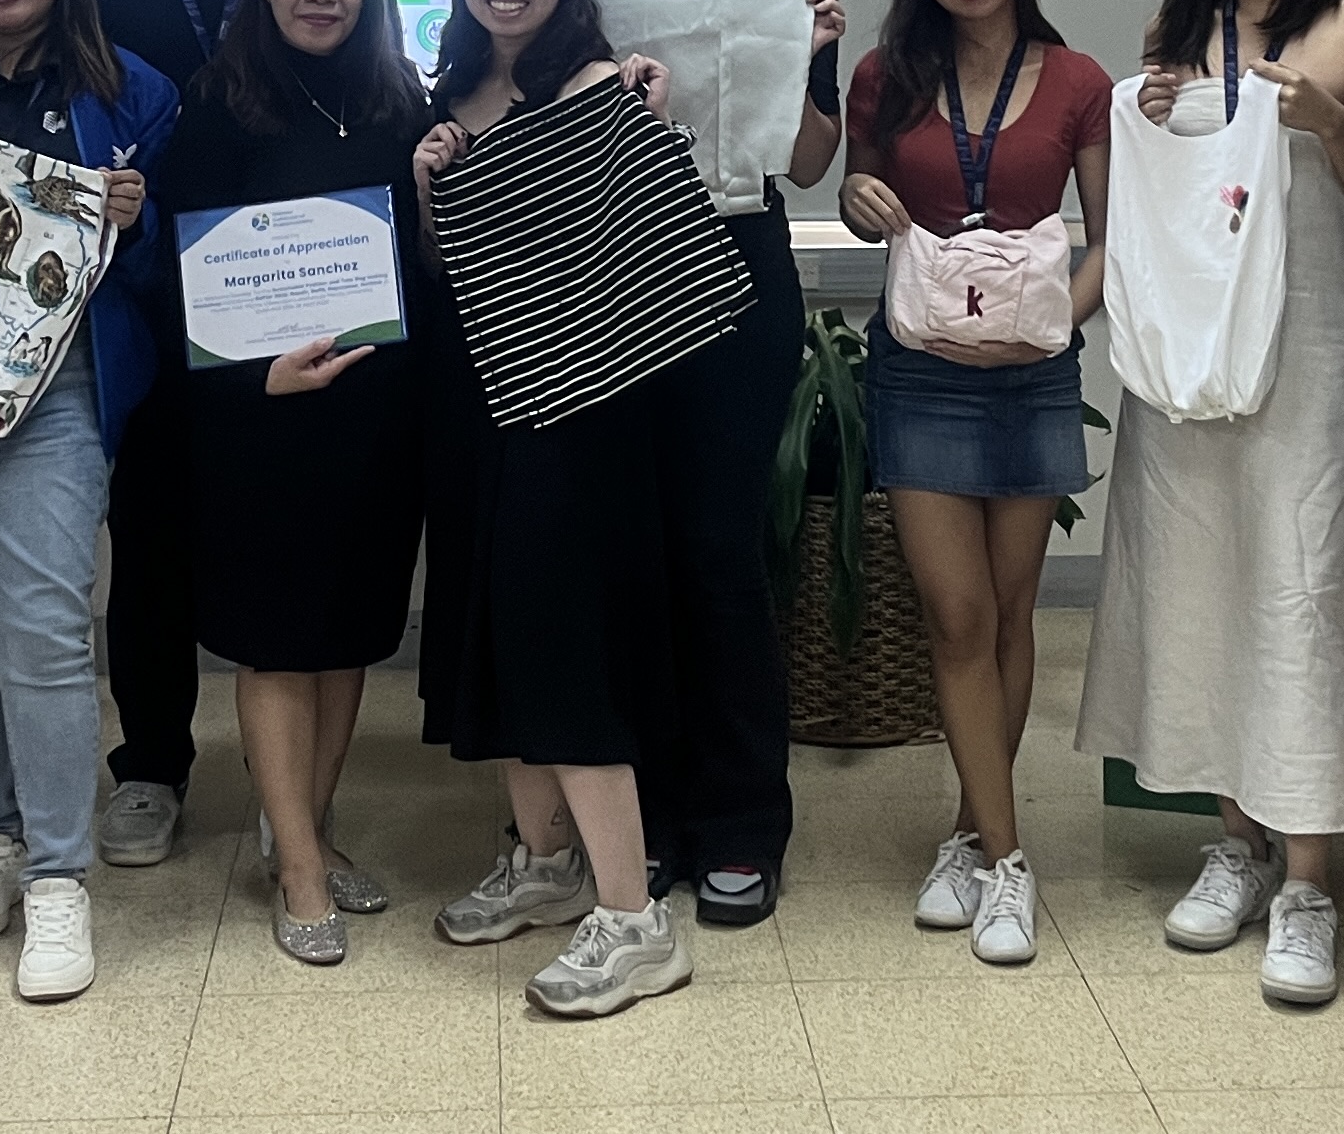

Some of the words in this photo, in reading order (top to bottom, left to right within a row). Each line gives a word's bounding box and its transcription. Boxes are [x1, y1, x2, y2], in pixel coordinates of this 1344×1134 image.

[204, 244, 270, 265] Certificate
[273, 244, 285, 256] of
[288, 234, 370, 255] Appreciation
[224, 269, 295, 288] Margarita
[299, 261, 359, 278] Sanchez
